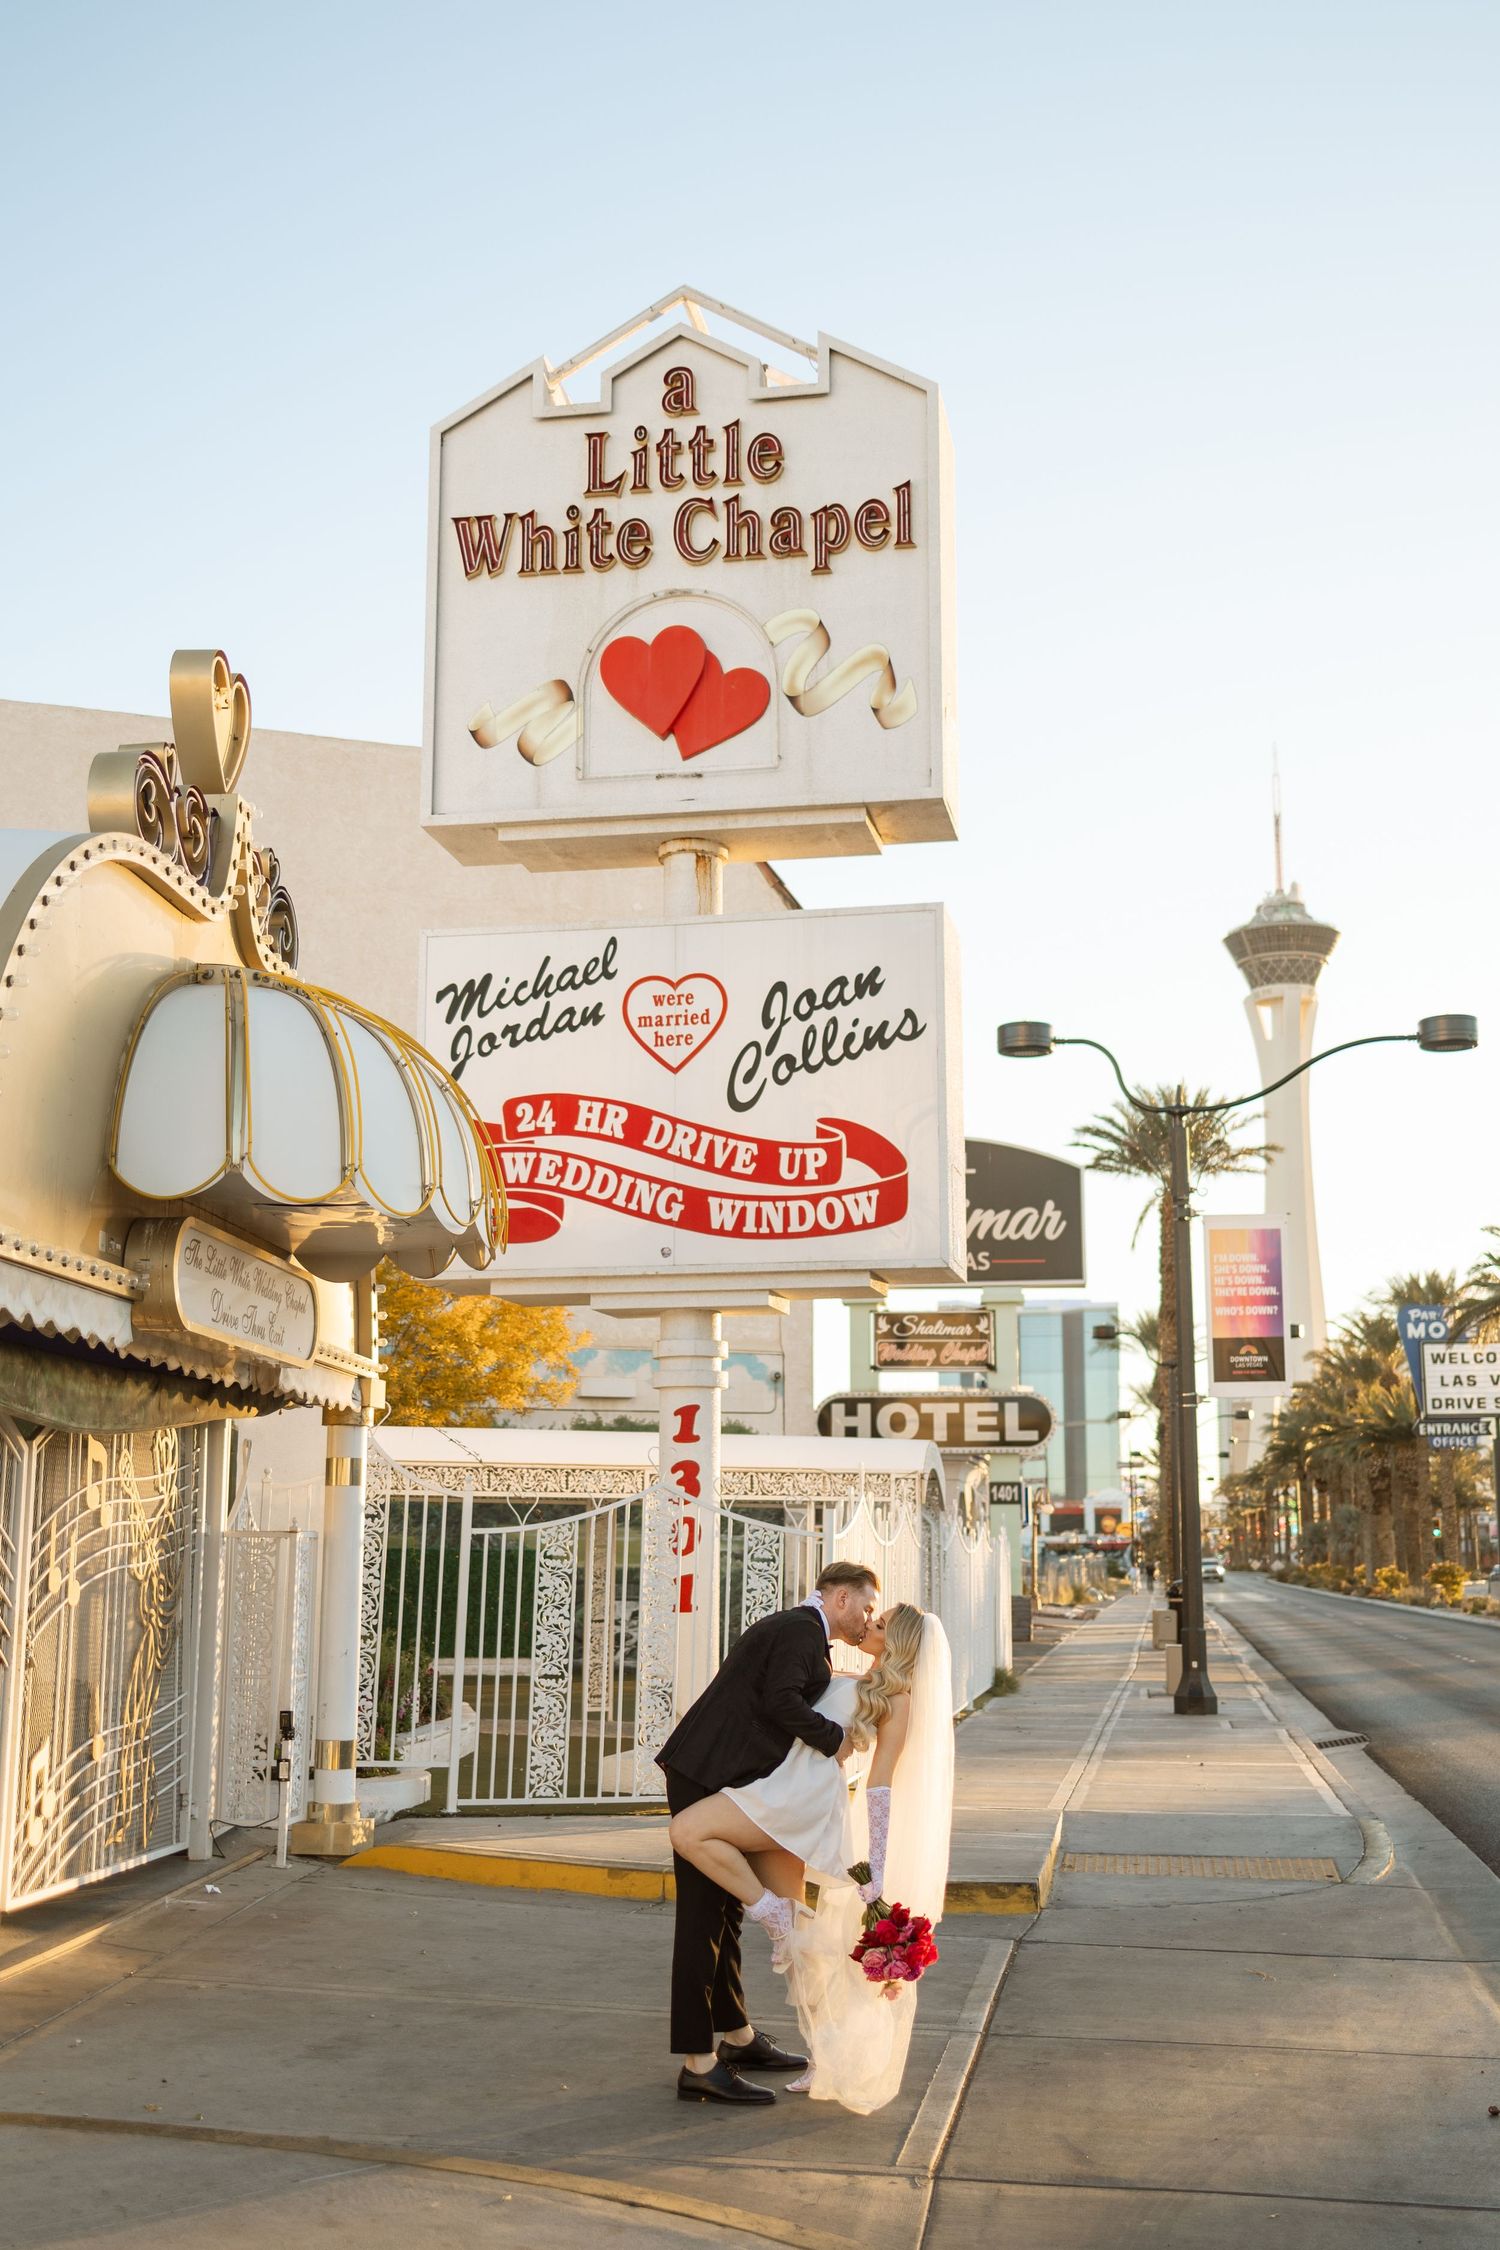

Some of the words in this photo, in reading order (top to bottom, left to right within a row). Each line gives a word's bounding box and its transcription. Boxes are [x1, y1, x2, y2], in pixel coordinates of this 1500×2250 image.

[661, 366, 699, 417] a
[583, 418, 784, 498] Little
[451, 504, 653, 579] White
[673, 480, 917, 575] Chapel
[436, 937, 618, 1025] Michael
[653, 992, 695, 1007] were
[637, 1009, 711, 1028] married
[761, 965, 886, 1056] Joan
[450, 1001, 605, 1081] Jordan
[654, 1030, 694, 1047] here
[727, 1008, 927, 1112] Collins
[516, 1102, 556, 1134] 24
[574, 1099, 630, 1139] HR
[643, 1116, 759, 1175] DRIVE
[778, 1147, 828, 1181] UP
[502, 1152, 686, 1222] WEDDING
[707, 1189, 881, 1234] WINDOW
[967, 1199, 1067, 1241] mar
[1229, 1253, 1259, 1263] DOWN.
[1238, 1263, 1270, 1273] DOWN.
[184, 1238, 203, 1270] The
[205, 1245, 228, 1281] Little
[229, 1256, 251, 1291] White
[253, 1267, 282, 1313] Wedding
[284, 1280, 309, 1319] Chapel
[1234, 1275, 1265, 1285] DOWN.
[1248, 1286, 1280, 1296] DOWN.
[211, 1288, 239, 1330] Drive
[242, 1304, 266, 1341] Thru
[268, 1311, 285, 1347] Exit
[1214, 1305, 1244, 1316] WHO'S
[1245, 1305, 1279, 1315] DOWN?
[893, 1315, 973, 1336] Shalimar
[1431, 1352, 1497, 1364] WELCO
[1441, 1375, 1477, 1387] LAS
[1432, 1398, 1487, 1409] DRIVE
[830, 1402, 1039, 1442] HOTEL
[1419, 1423, 1488, 1436] ENTRANCE
[1432, 1437, 1474, 1448] OFFICE
[991, 1485, 1019, 1501] 1401
